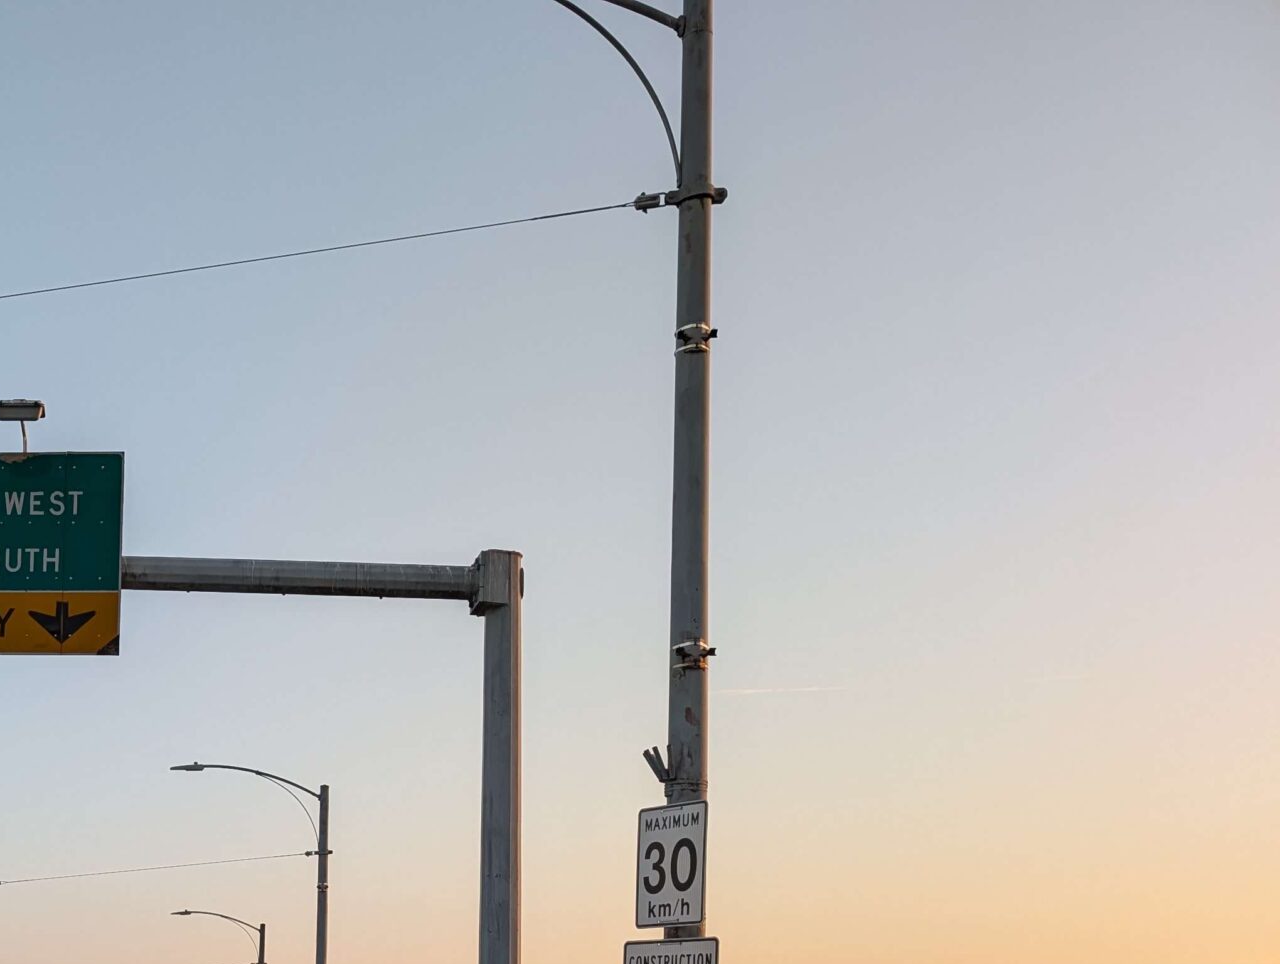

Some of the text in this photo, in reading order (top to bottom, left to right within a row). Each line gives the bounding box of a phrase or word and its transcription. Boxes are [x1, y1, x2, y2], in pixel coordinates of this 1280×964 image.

[4, 491, 84, 515] WEST
[645, 812, 700, 832] MAXIMUM
[643, 838, 697, 894] 30
[648, 898, 690, 918] km/h
